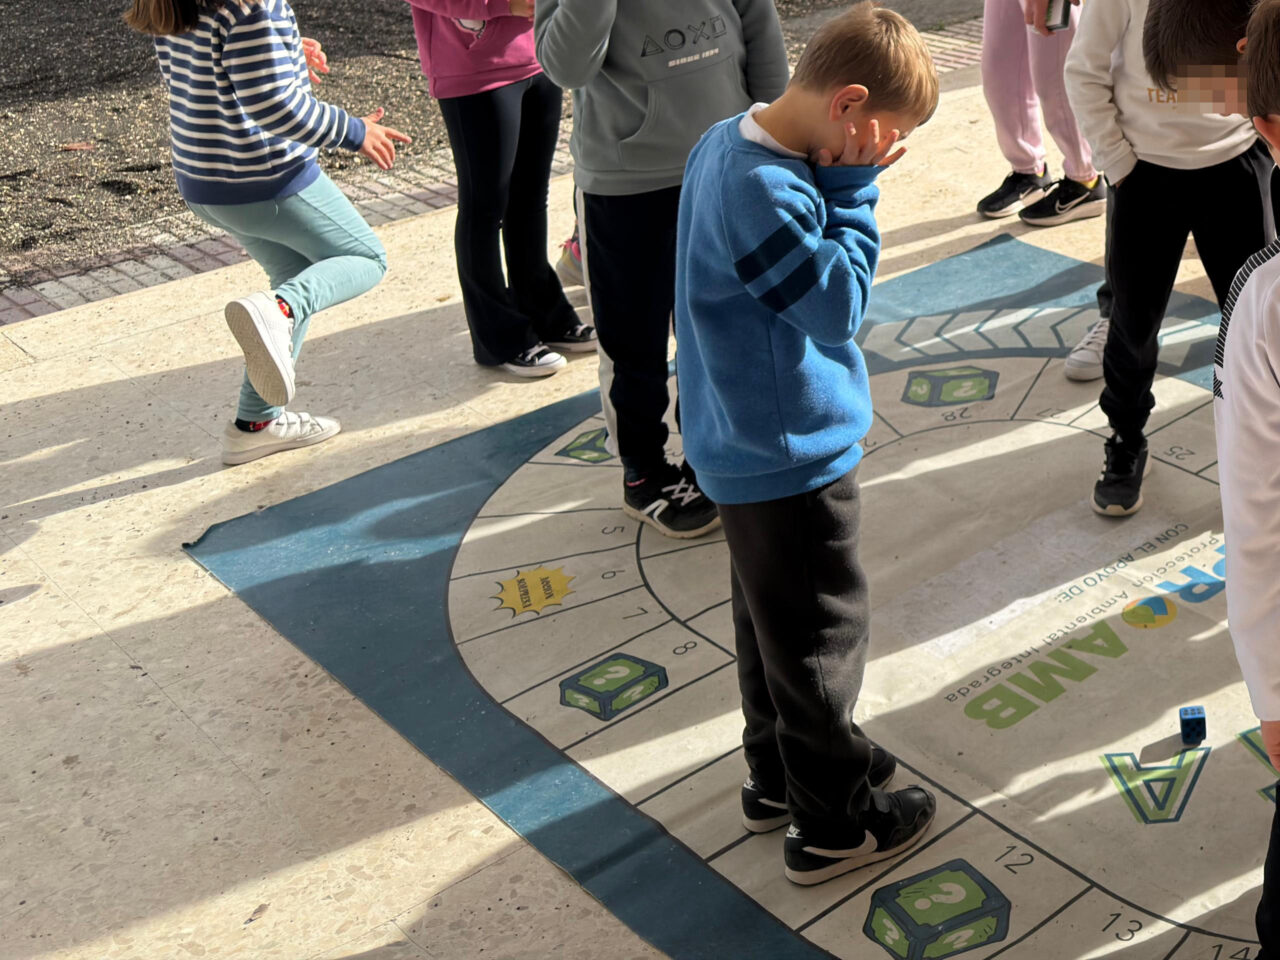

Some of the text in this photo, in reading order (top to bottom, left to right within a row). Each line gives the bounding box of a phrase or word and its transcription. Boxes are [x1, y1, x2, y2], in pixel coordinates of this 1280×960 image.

[1147, 87, 1178, 104] TEA
[941, 406, 973, 423] 28
[1163, 445, 1196, 461] 25
[601, 525, 624, 535] 5
[1054, 522, 1189, 604] CON EL APOYO DE:
[601, 569, 626, 580] 6
[622, 606, 648, 620] 7
[944, 534, 1219, 704] Protección Ambiental Integrada
[673, 640, 698, 656] 8
[994, 844, 1035, 875] 12
[1101, 912, 1144, 942] 13
